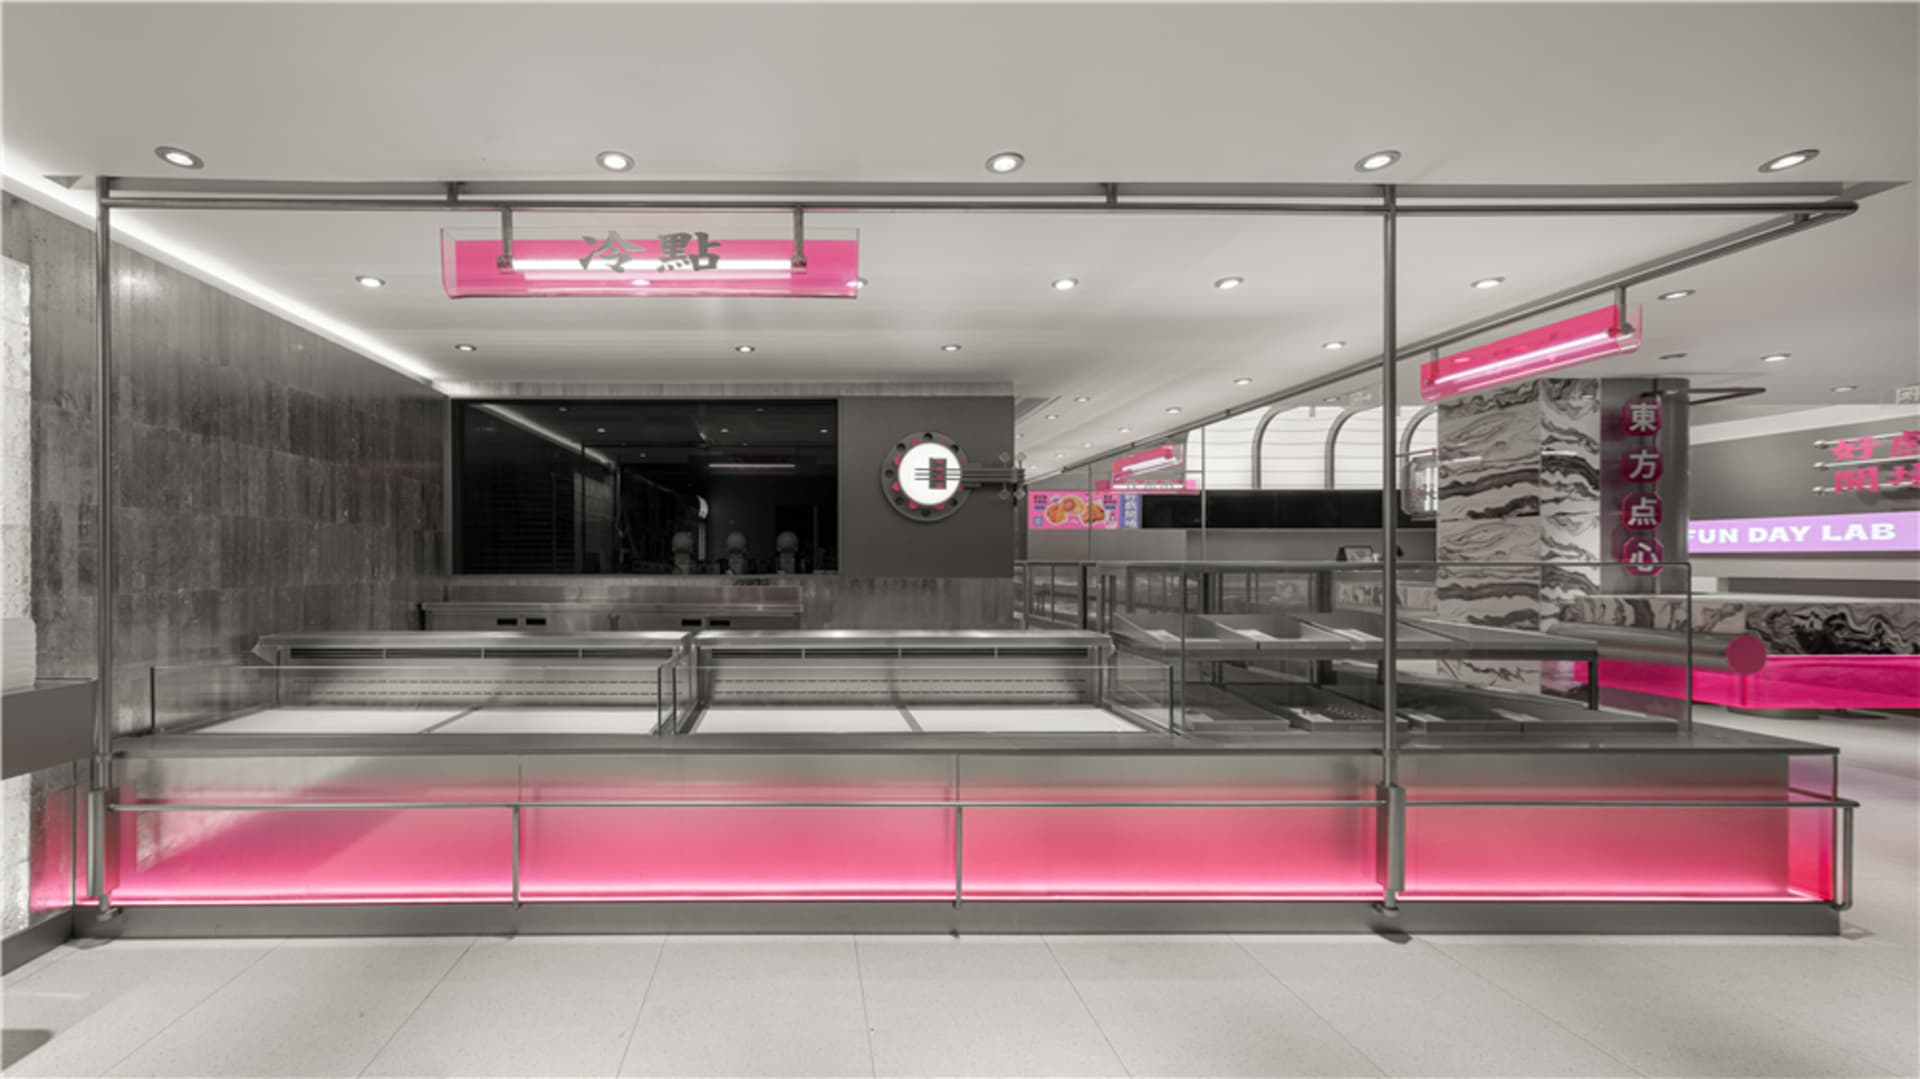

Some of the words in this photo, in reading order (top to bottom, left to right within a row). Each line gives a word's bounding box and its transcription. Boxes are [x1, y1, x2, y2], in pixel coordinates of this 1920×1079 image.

[579, 230, 721, 273] 冷點
[1627, 402, 1661, 573] 東方点心
[1748, 525, 1811, 543] DAY
[1821, 522, 1896, 541] LAB
